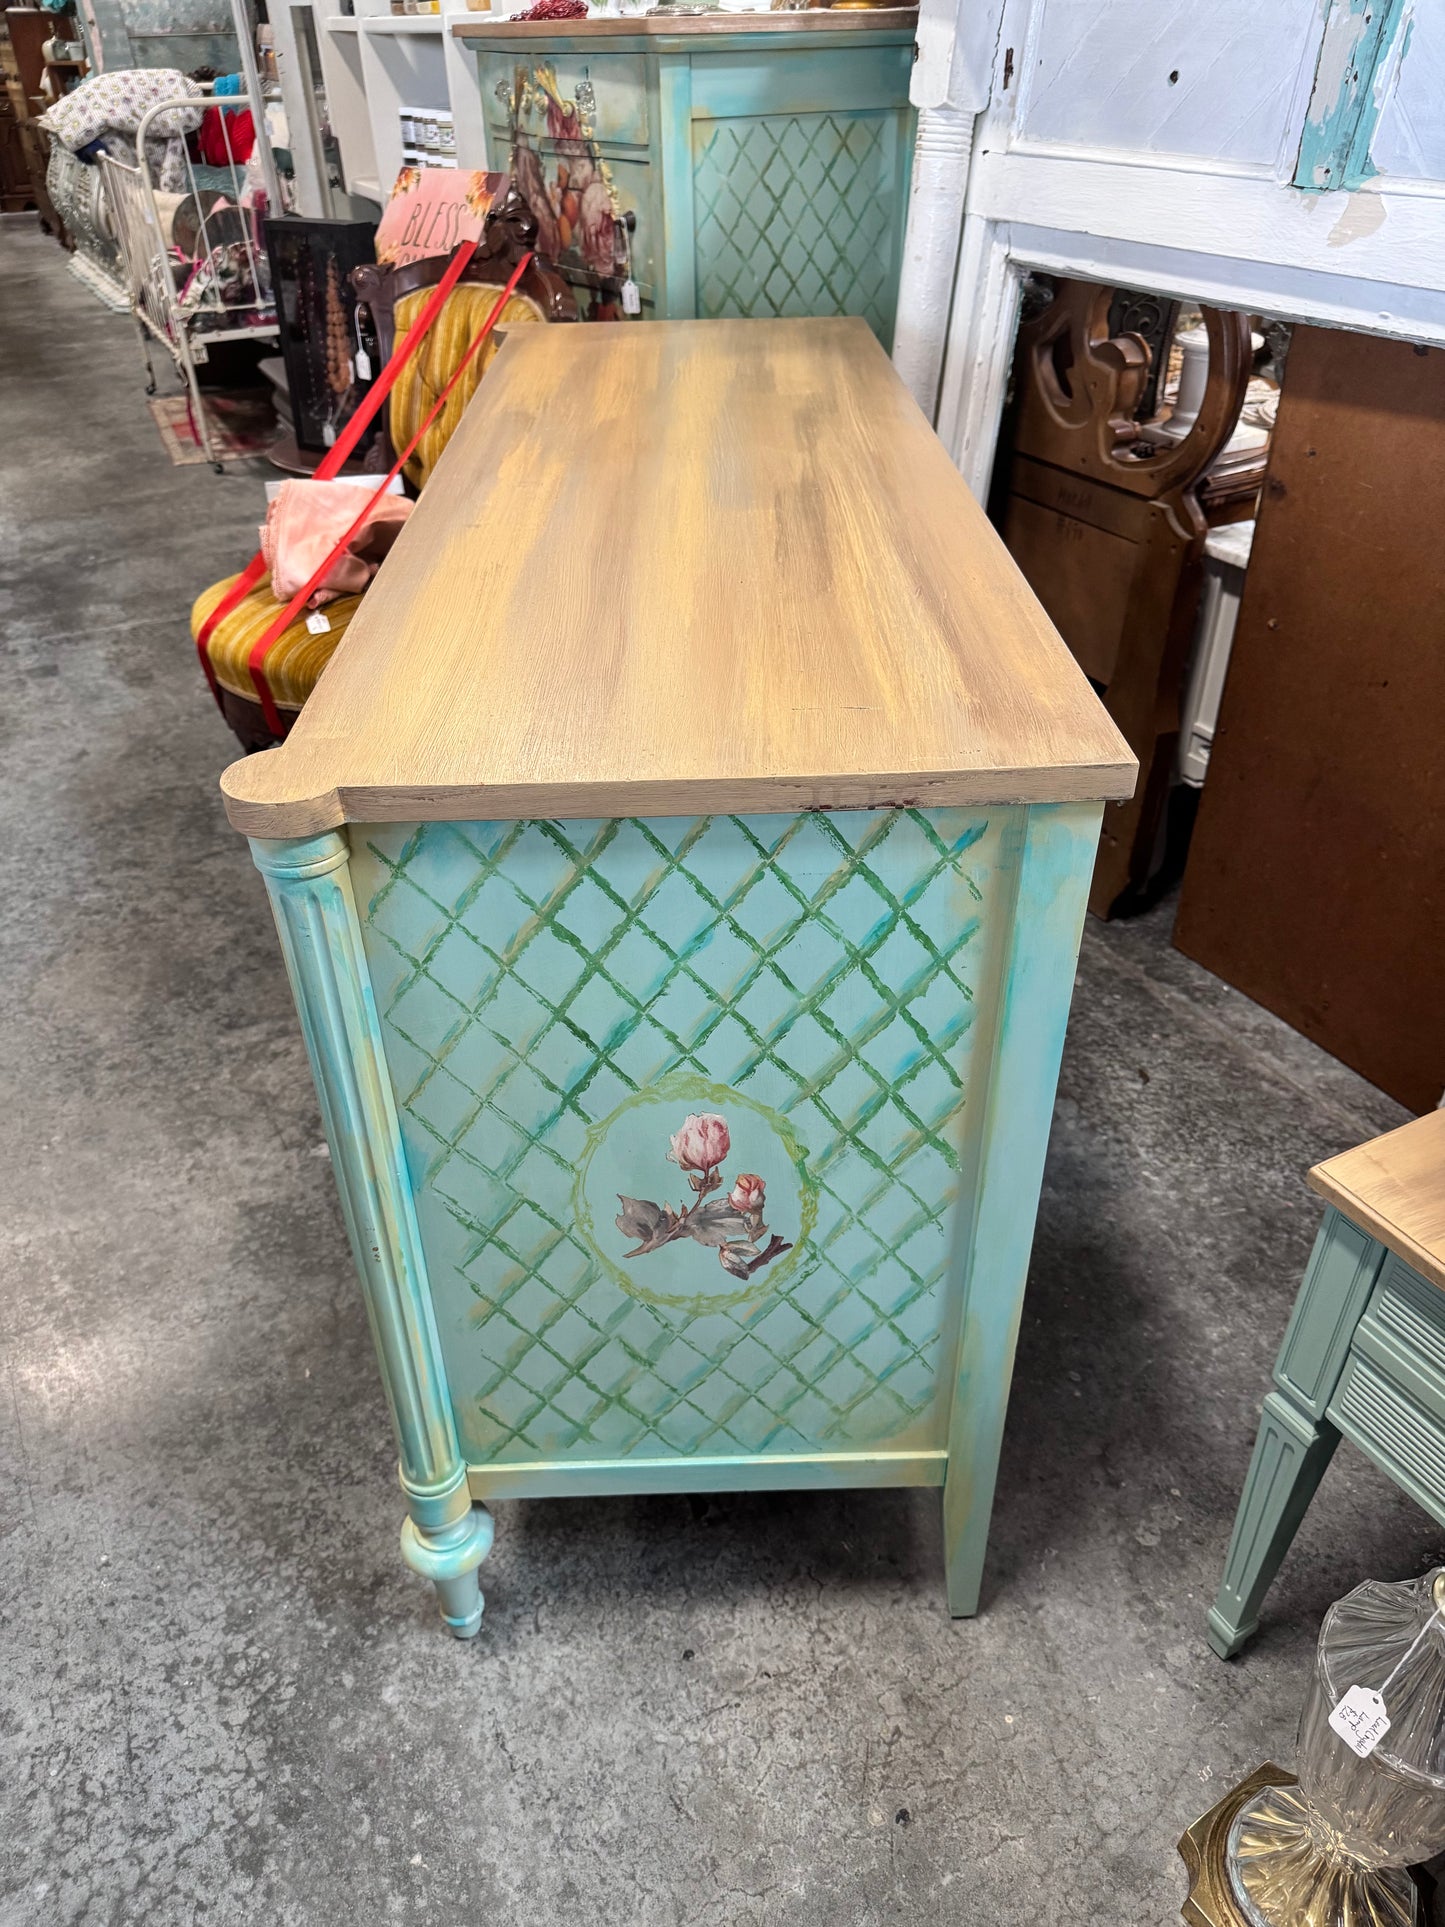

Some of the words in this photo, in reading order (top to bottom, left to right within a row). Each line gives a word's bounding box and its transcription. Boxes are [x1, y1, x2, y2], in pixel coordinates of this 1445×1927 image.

[401, 201, 467, 251] BLESS
[1348, 1712, 1369, 1731] Lamp
[1369, 1716, 1387, 1735] Lead
[1354, 1730, 1375, 1753] Crystal
